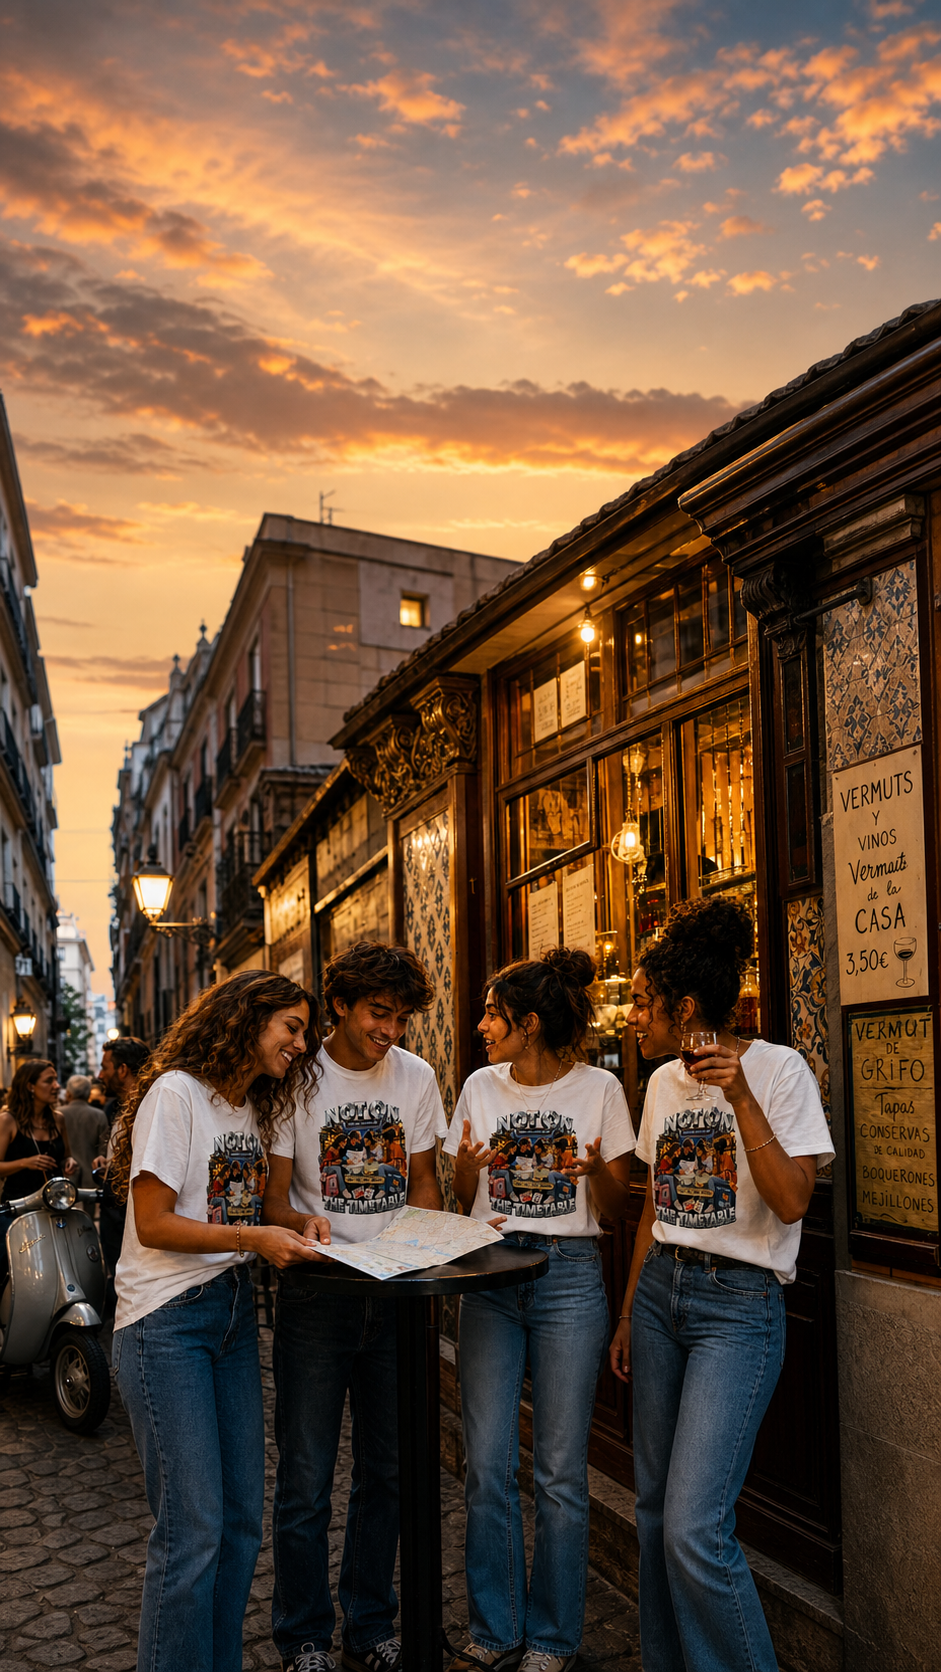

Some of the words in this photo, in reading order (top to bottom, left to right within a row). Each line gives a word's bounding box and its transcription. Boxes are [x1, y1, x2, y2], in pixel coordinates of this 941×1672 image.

[840, 770, 913, 812] VERMUTS
[872, 810, 880, 826] Y
[858, 828, 897, 851] VINOS
[867, 887, 879, 902] de
[887, 880, 901, 896] la
[855, 902, 906, 934] CASA
[846, 949, 889, 976] 3,50€
[855, 1017, 931, 1041] VERMUT
[886, 1042, 900, 1055] DE
[875, 1092, 915, 1122] Tapas
[497, 1110, 540, 1134] NOT
[860, 1123, 930, 1143] CONSERVAS
[874, 1145, 883, 1155] DE
[886, 1145, 926, 1160] CALIDAD
[862, 1165, 935, 1188] BOQUERONES
[322, 1196, 346, 1213] THE
[346, 1191, 406, 1214] TIMETABLE
[490, 1197, 512, 1215] THE
[512, 1198, 576, 1218] TIMETABLE
[656, 1205, 677, 1226] THE
[677, 1207, 736, 1229] TIMETABLE
